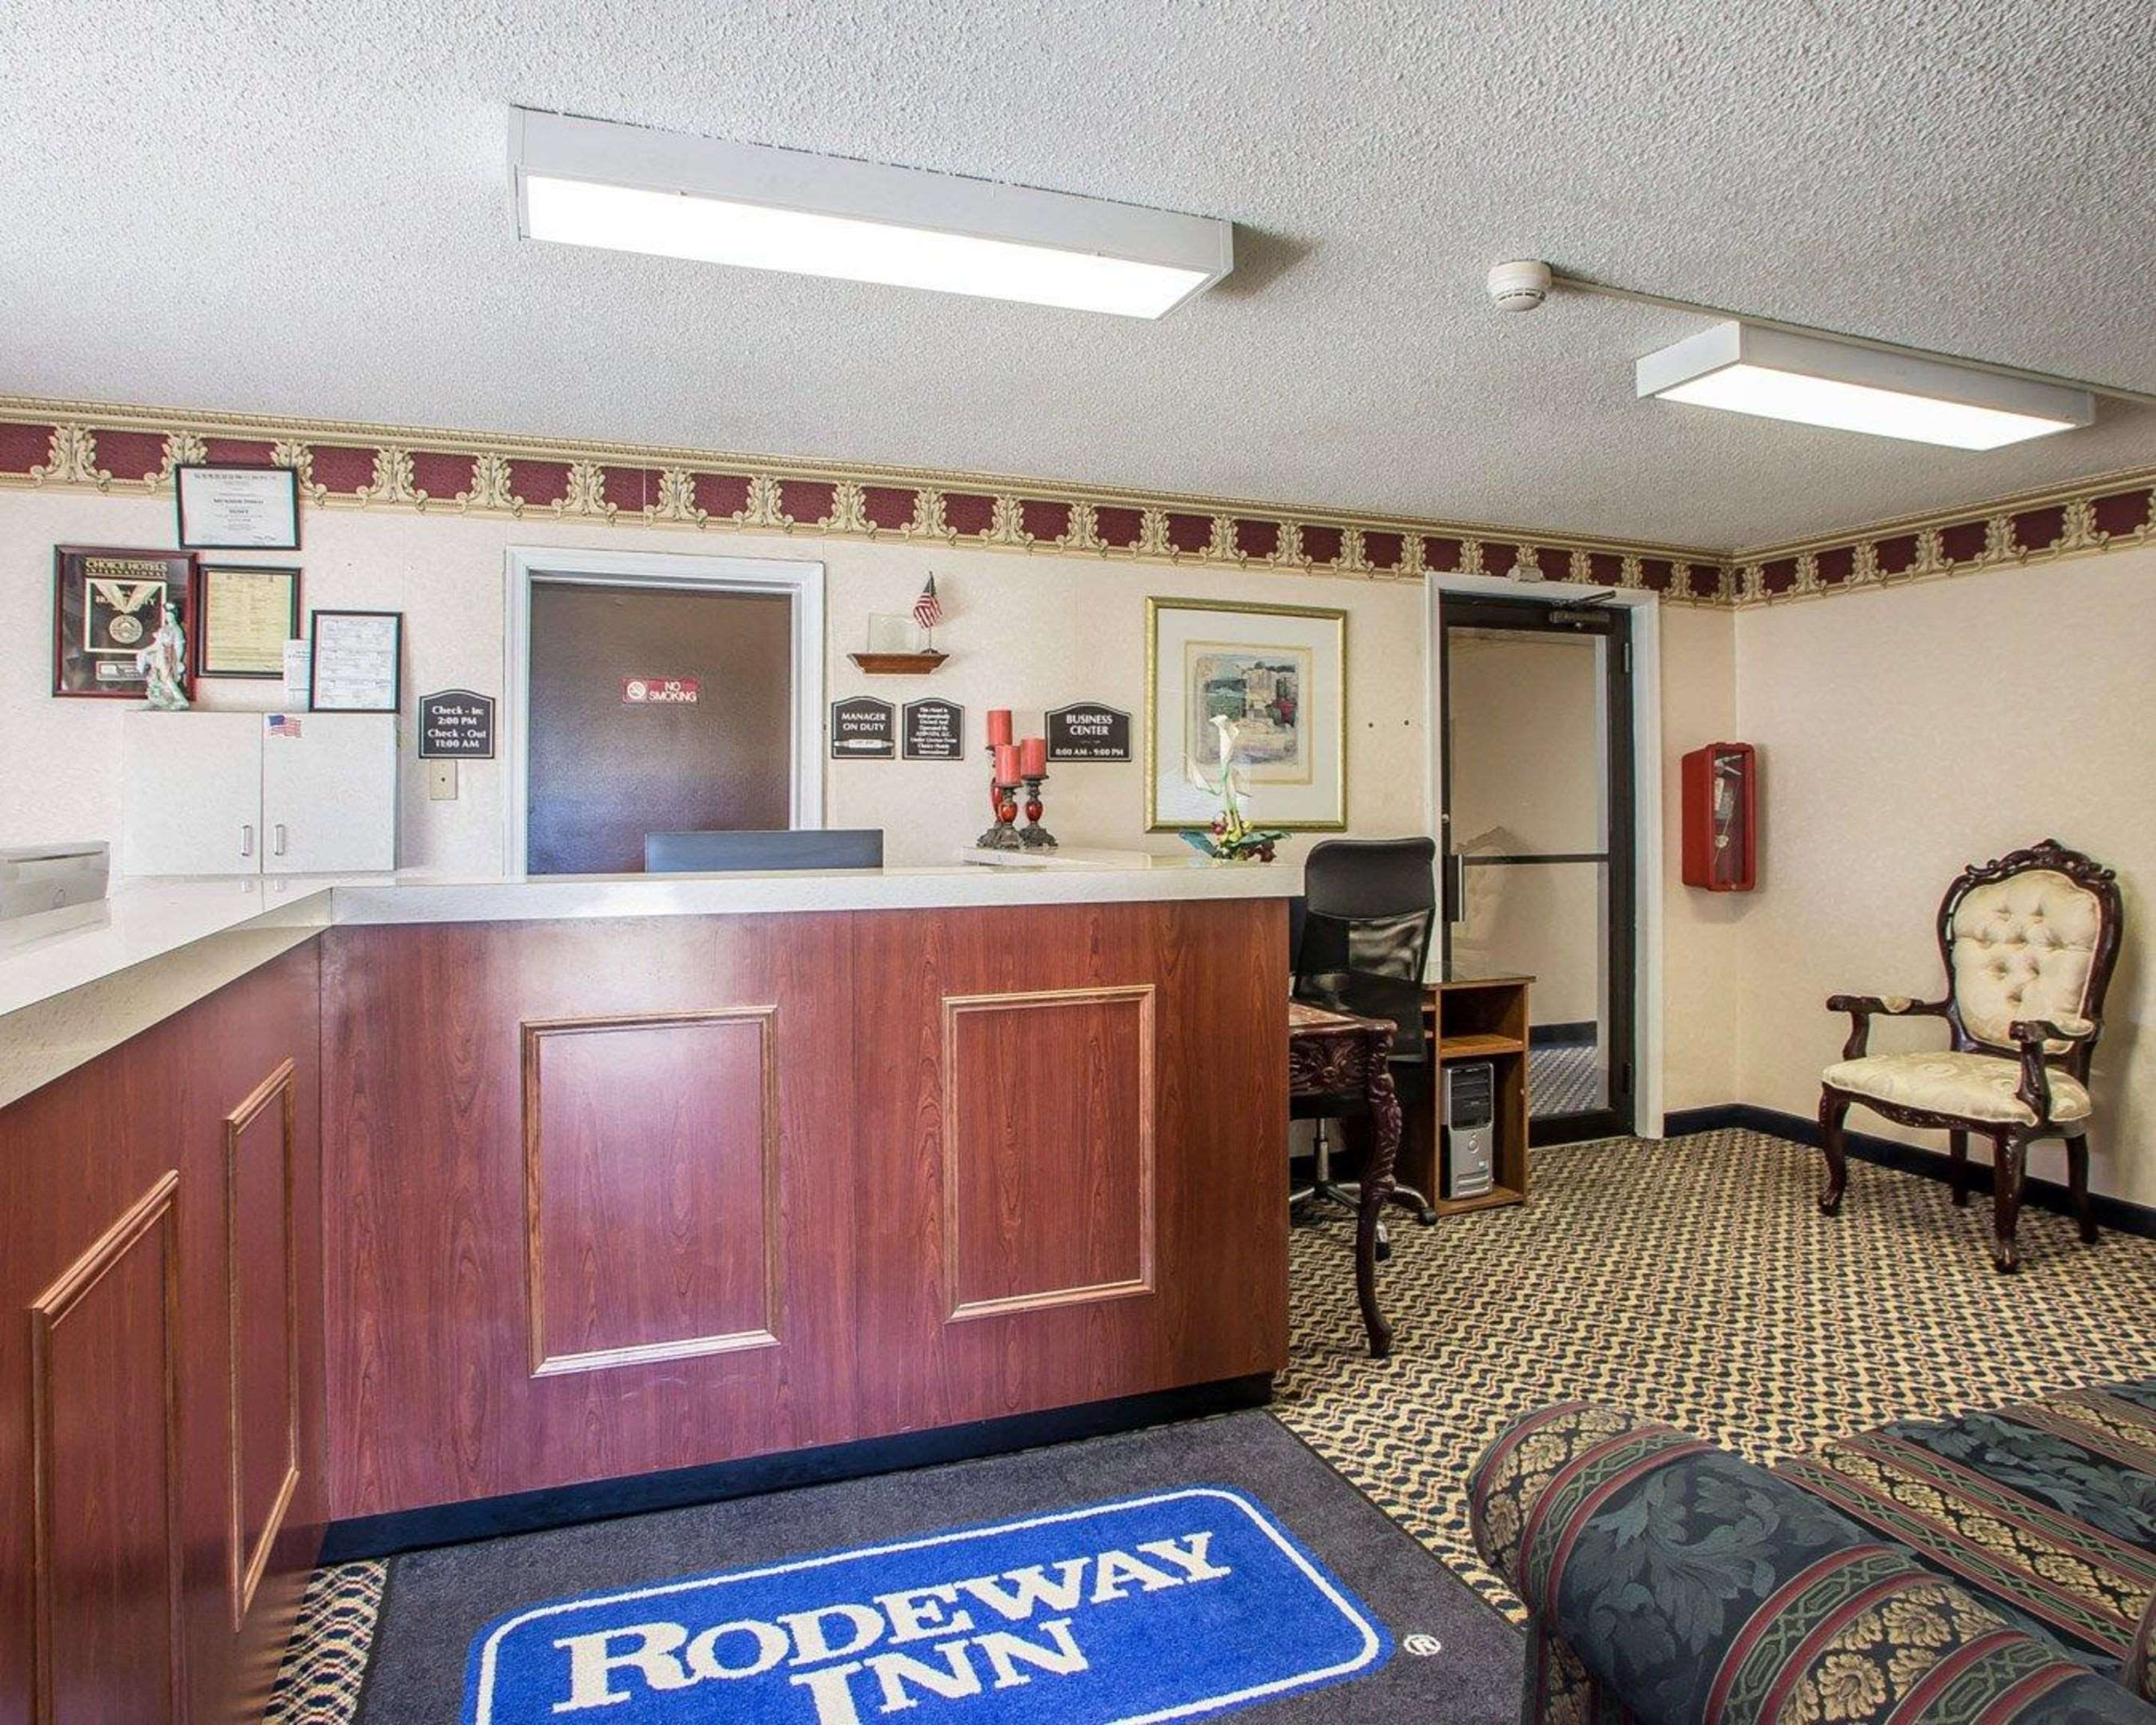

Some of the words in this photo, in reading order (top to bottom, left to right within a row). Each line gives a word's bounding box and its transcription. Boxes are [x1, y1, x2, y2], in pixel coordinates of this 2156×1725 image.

[664, 681, 681, 692] NO
[649, 691, 697, 702] SMOKING
[432, 706, 463, 715] Check
[841, 712, 886, 720] MANAGER
[1066, 714, 1113, 724] BUSINESS
[427, 729, 459, 738] Check
[467, 730, 487, 738] Out
[1070, 725, 1109, 735] CENTER
[435, 740, 460, 748] 11:00
[462, 740, 479, 748] AM
[552, 1532, 1231, 1713] RODEWAY
[789, 1617, 1089, 1725] INN
